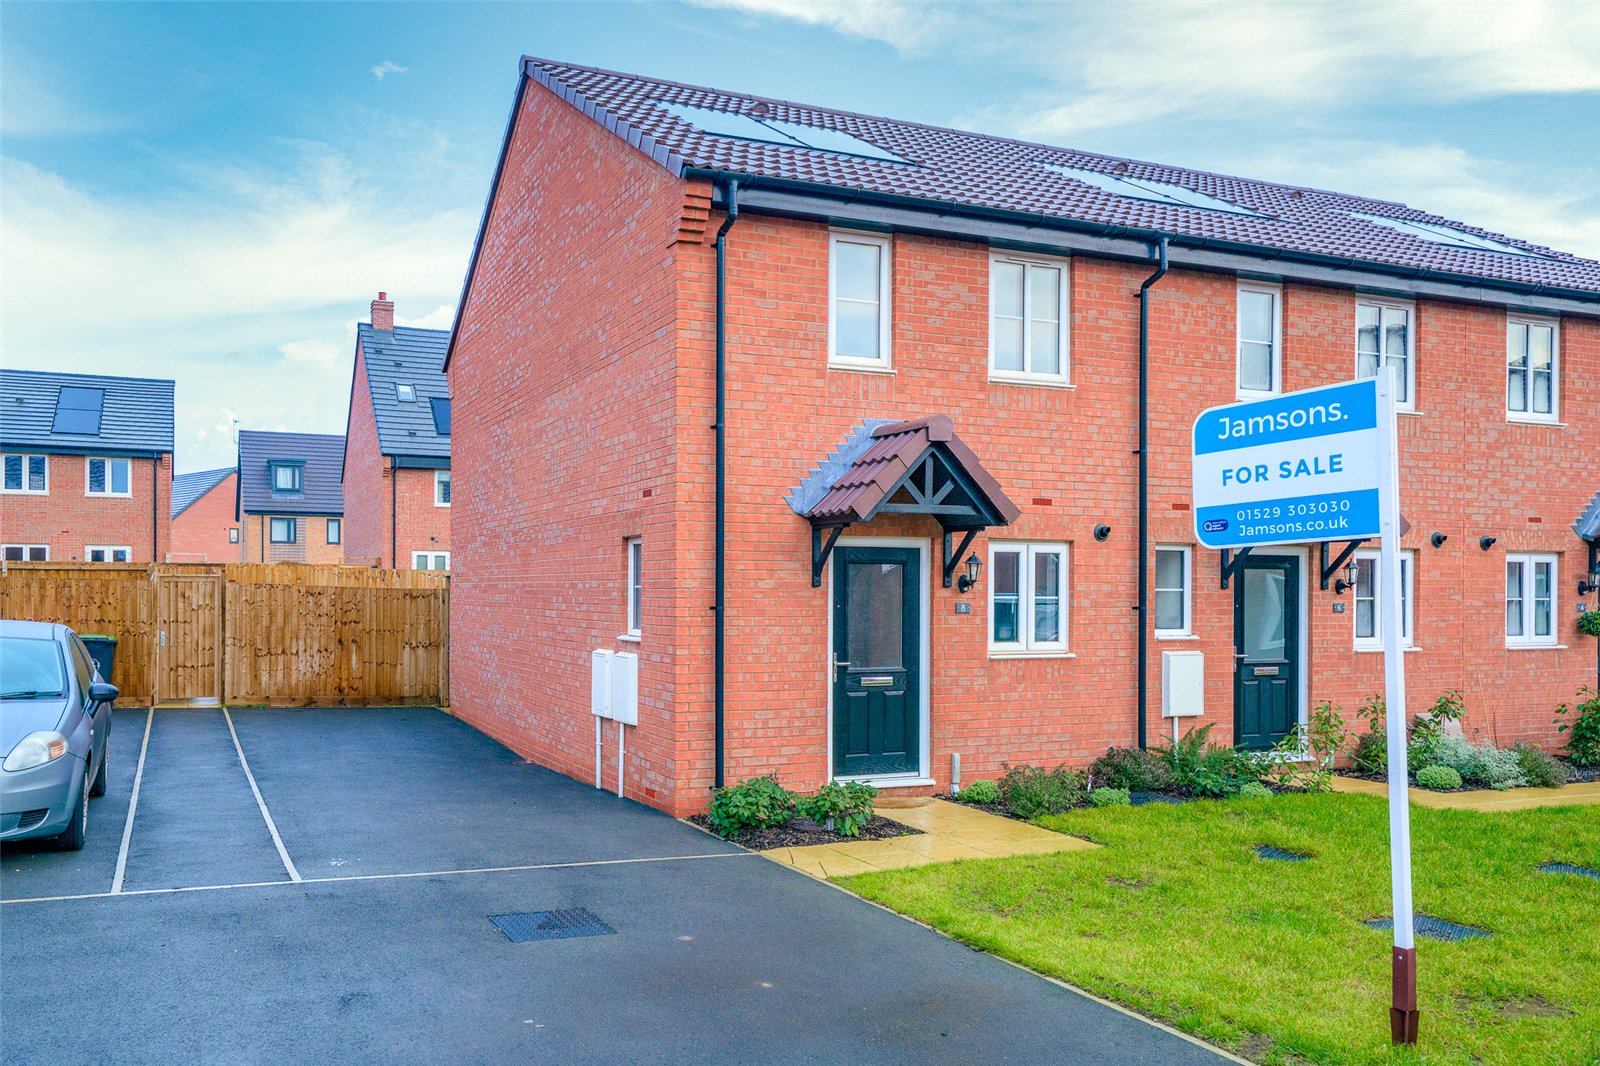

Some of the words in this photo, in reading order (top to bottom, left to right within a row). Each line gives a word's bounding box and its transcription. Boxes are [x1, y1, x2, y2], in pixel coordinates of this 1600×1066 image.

[1217, 402, 1349, 440] Jamsons.
[1221, 464, 1269, 487] FOR
[1279, 453, 1343, 479] SALE
[1236, 507, 1281, 521] 01529
[1287, 499, 1350, 517] 303030
[1239, 515, 1348, 537] Jamsons.co.uk
